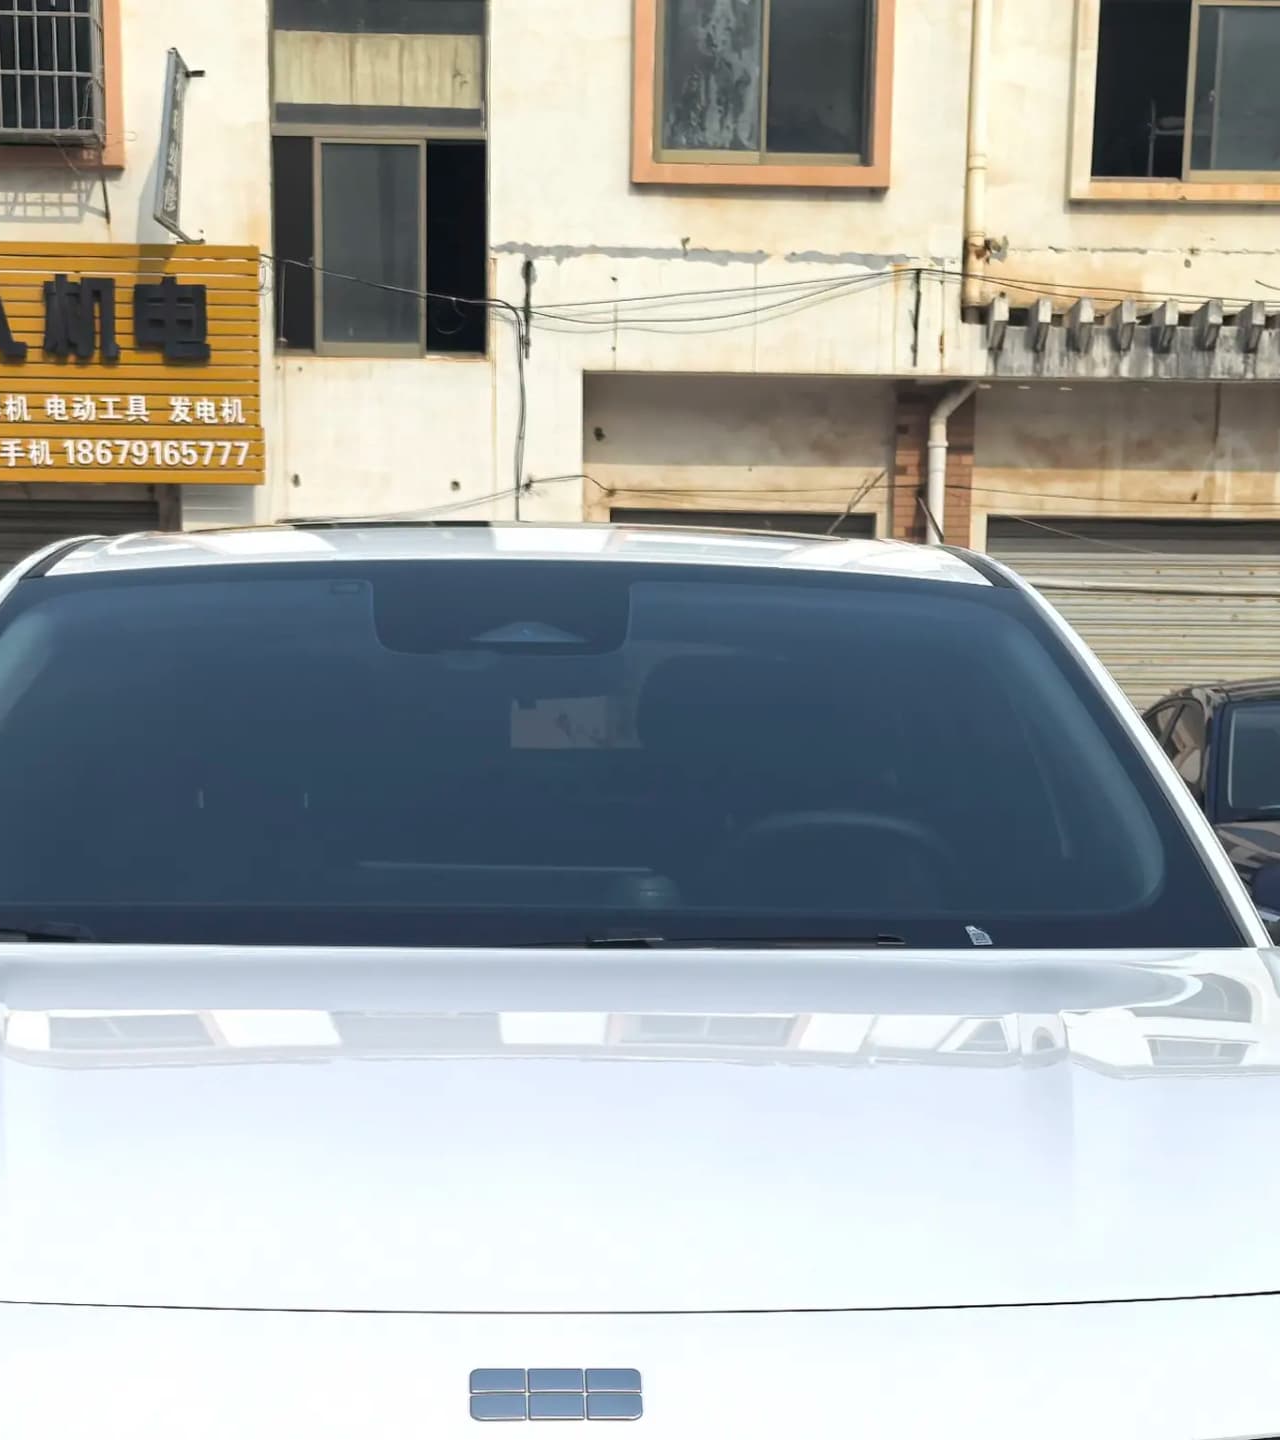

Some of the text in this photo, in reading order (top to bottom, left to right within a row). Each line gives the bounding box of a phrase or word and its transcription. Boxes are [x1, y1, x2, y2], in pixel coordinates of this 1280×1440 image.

[45, 394, 150, 423] 电动工具
[169, 396, 247, 424] 发电机
[0, 439, 250, 467] 手机 18679165777
